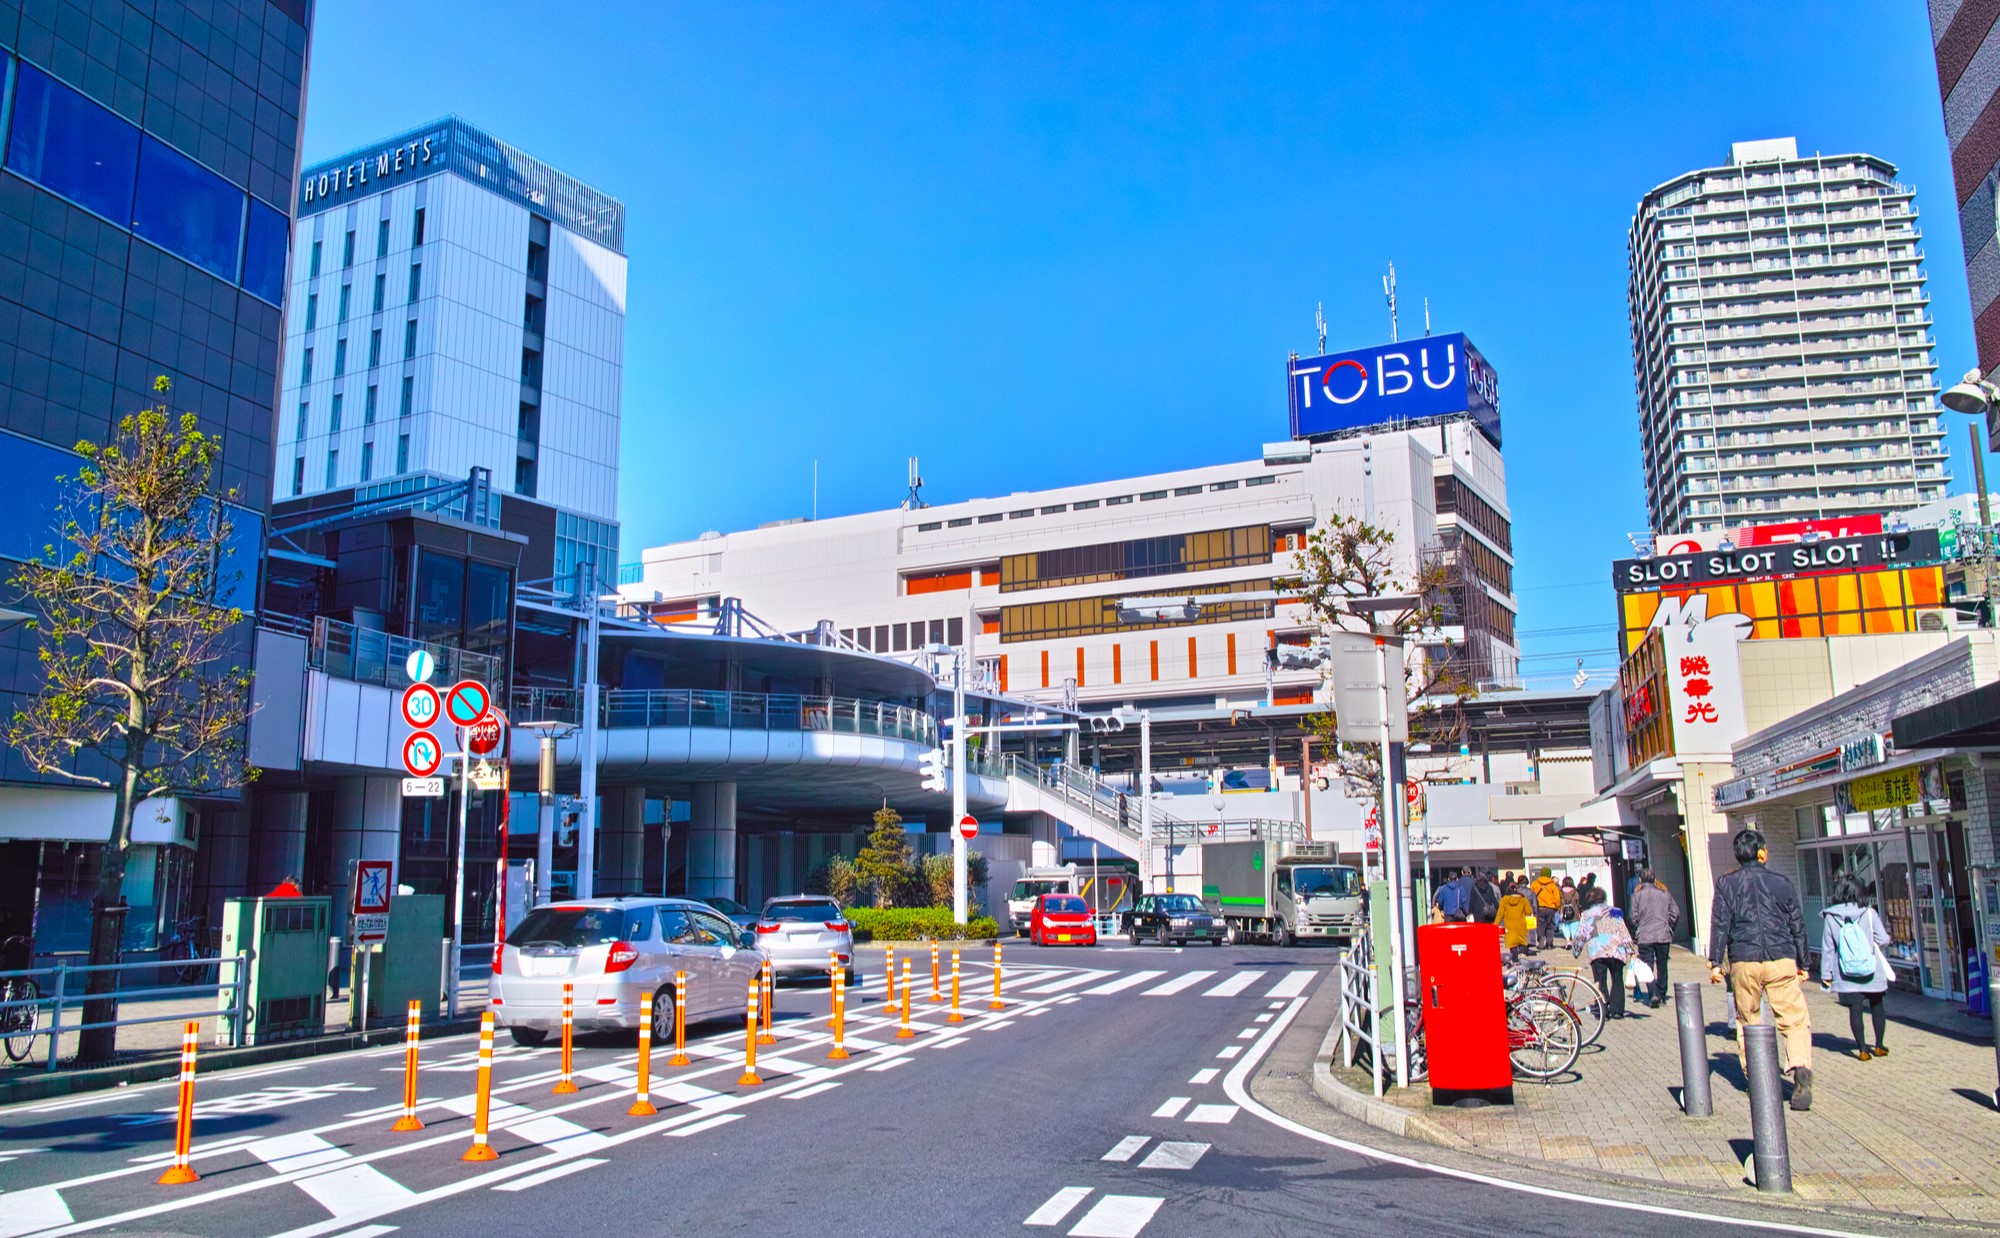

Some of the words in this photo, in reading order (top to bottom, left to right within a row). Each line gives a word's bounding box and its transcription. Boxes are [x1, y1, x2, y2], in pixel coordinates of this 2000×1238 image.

[305, 161, 367, 203] HOTEL
[376, 138, 431, 177] METS
[1292, 344, 1456, 408] TOBU
[1465, 349, 1500, 414] TOBU
[1629, 559, 1693, 583] SLOT
[1709, 551, 1776, 576] SLOT
[1793, 543, 1863, 569] SLOT
[411, 696, 432, 716] 30
[1885, 773, 1912, 803] 恵方巻
